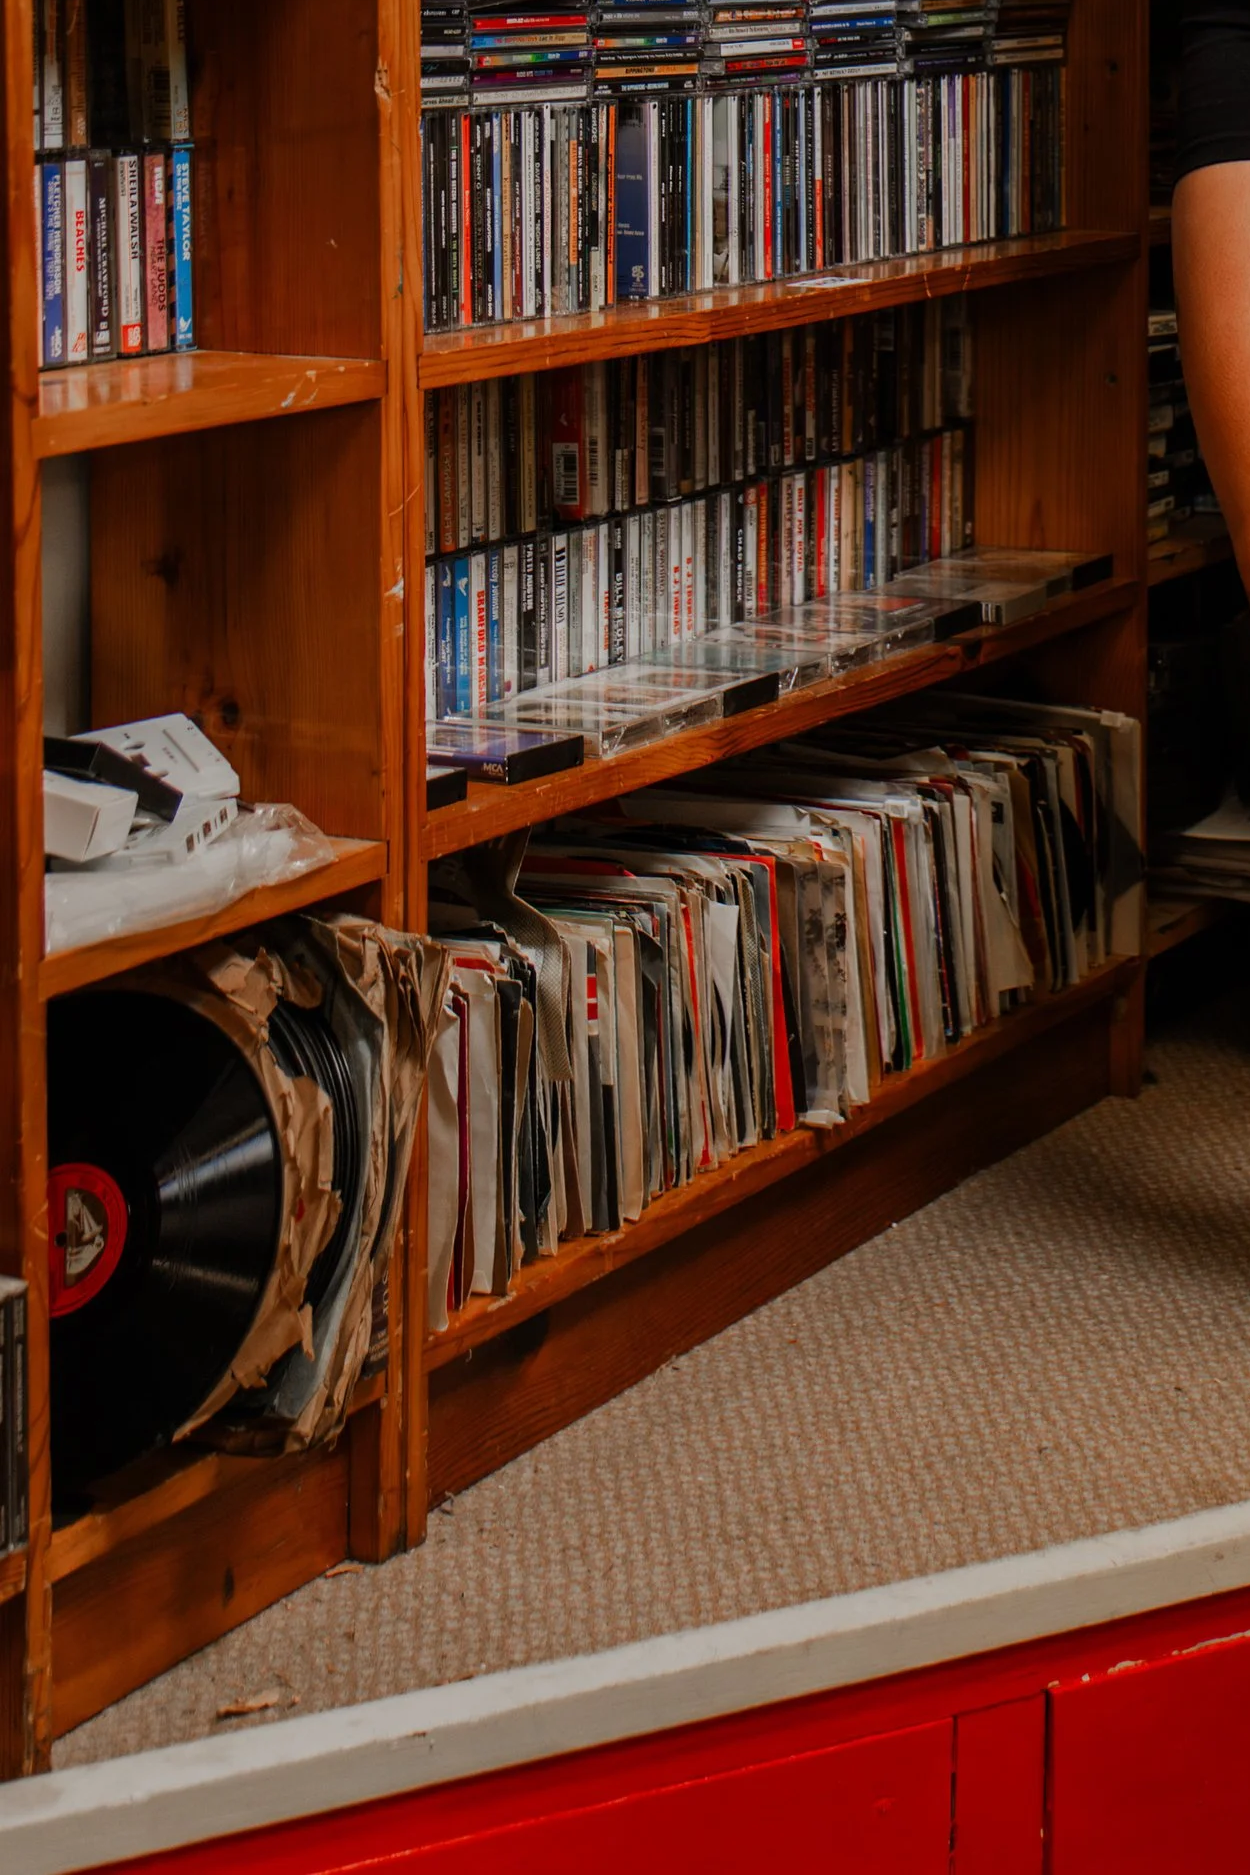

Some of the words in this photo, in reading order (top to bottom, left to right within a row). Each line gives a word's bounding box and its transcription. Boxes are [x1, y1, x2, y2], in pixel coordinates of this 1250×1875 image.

[129, 160, 138, 207] SHEILA
[181, 162, 190, 204] STEVE
[76, 210, 85, 272] BEACHES
[130, 210, 138, 260] WALSH
[157, 239, 165, 263] THE
[182, 206, 191, 261] TAYLOR
[157, 266, 167, 311] JUDDS
[615, 572, 623, 604] BILL
[615, 607, 623, 663] MEDLEY
